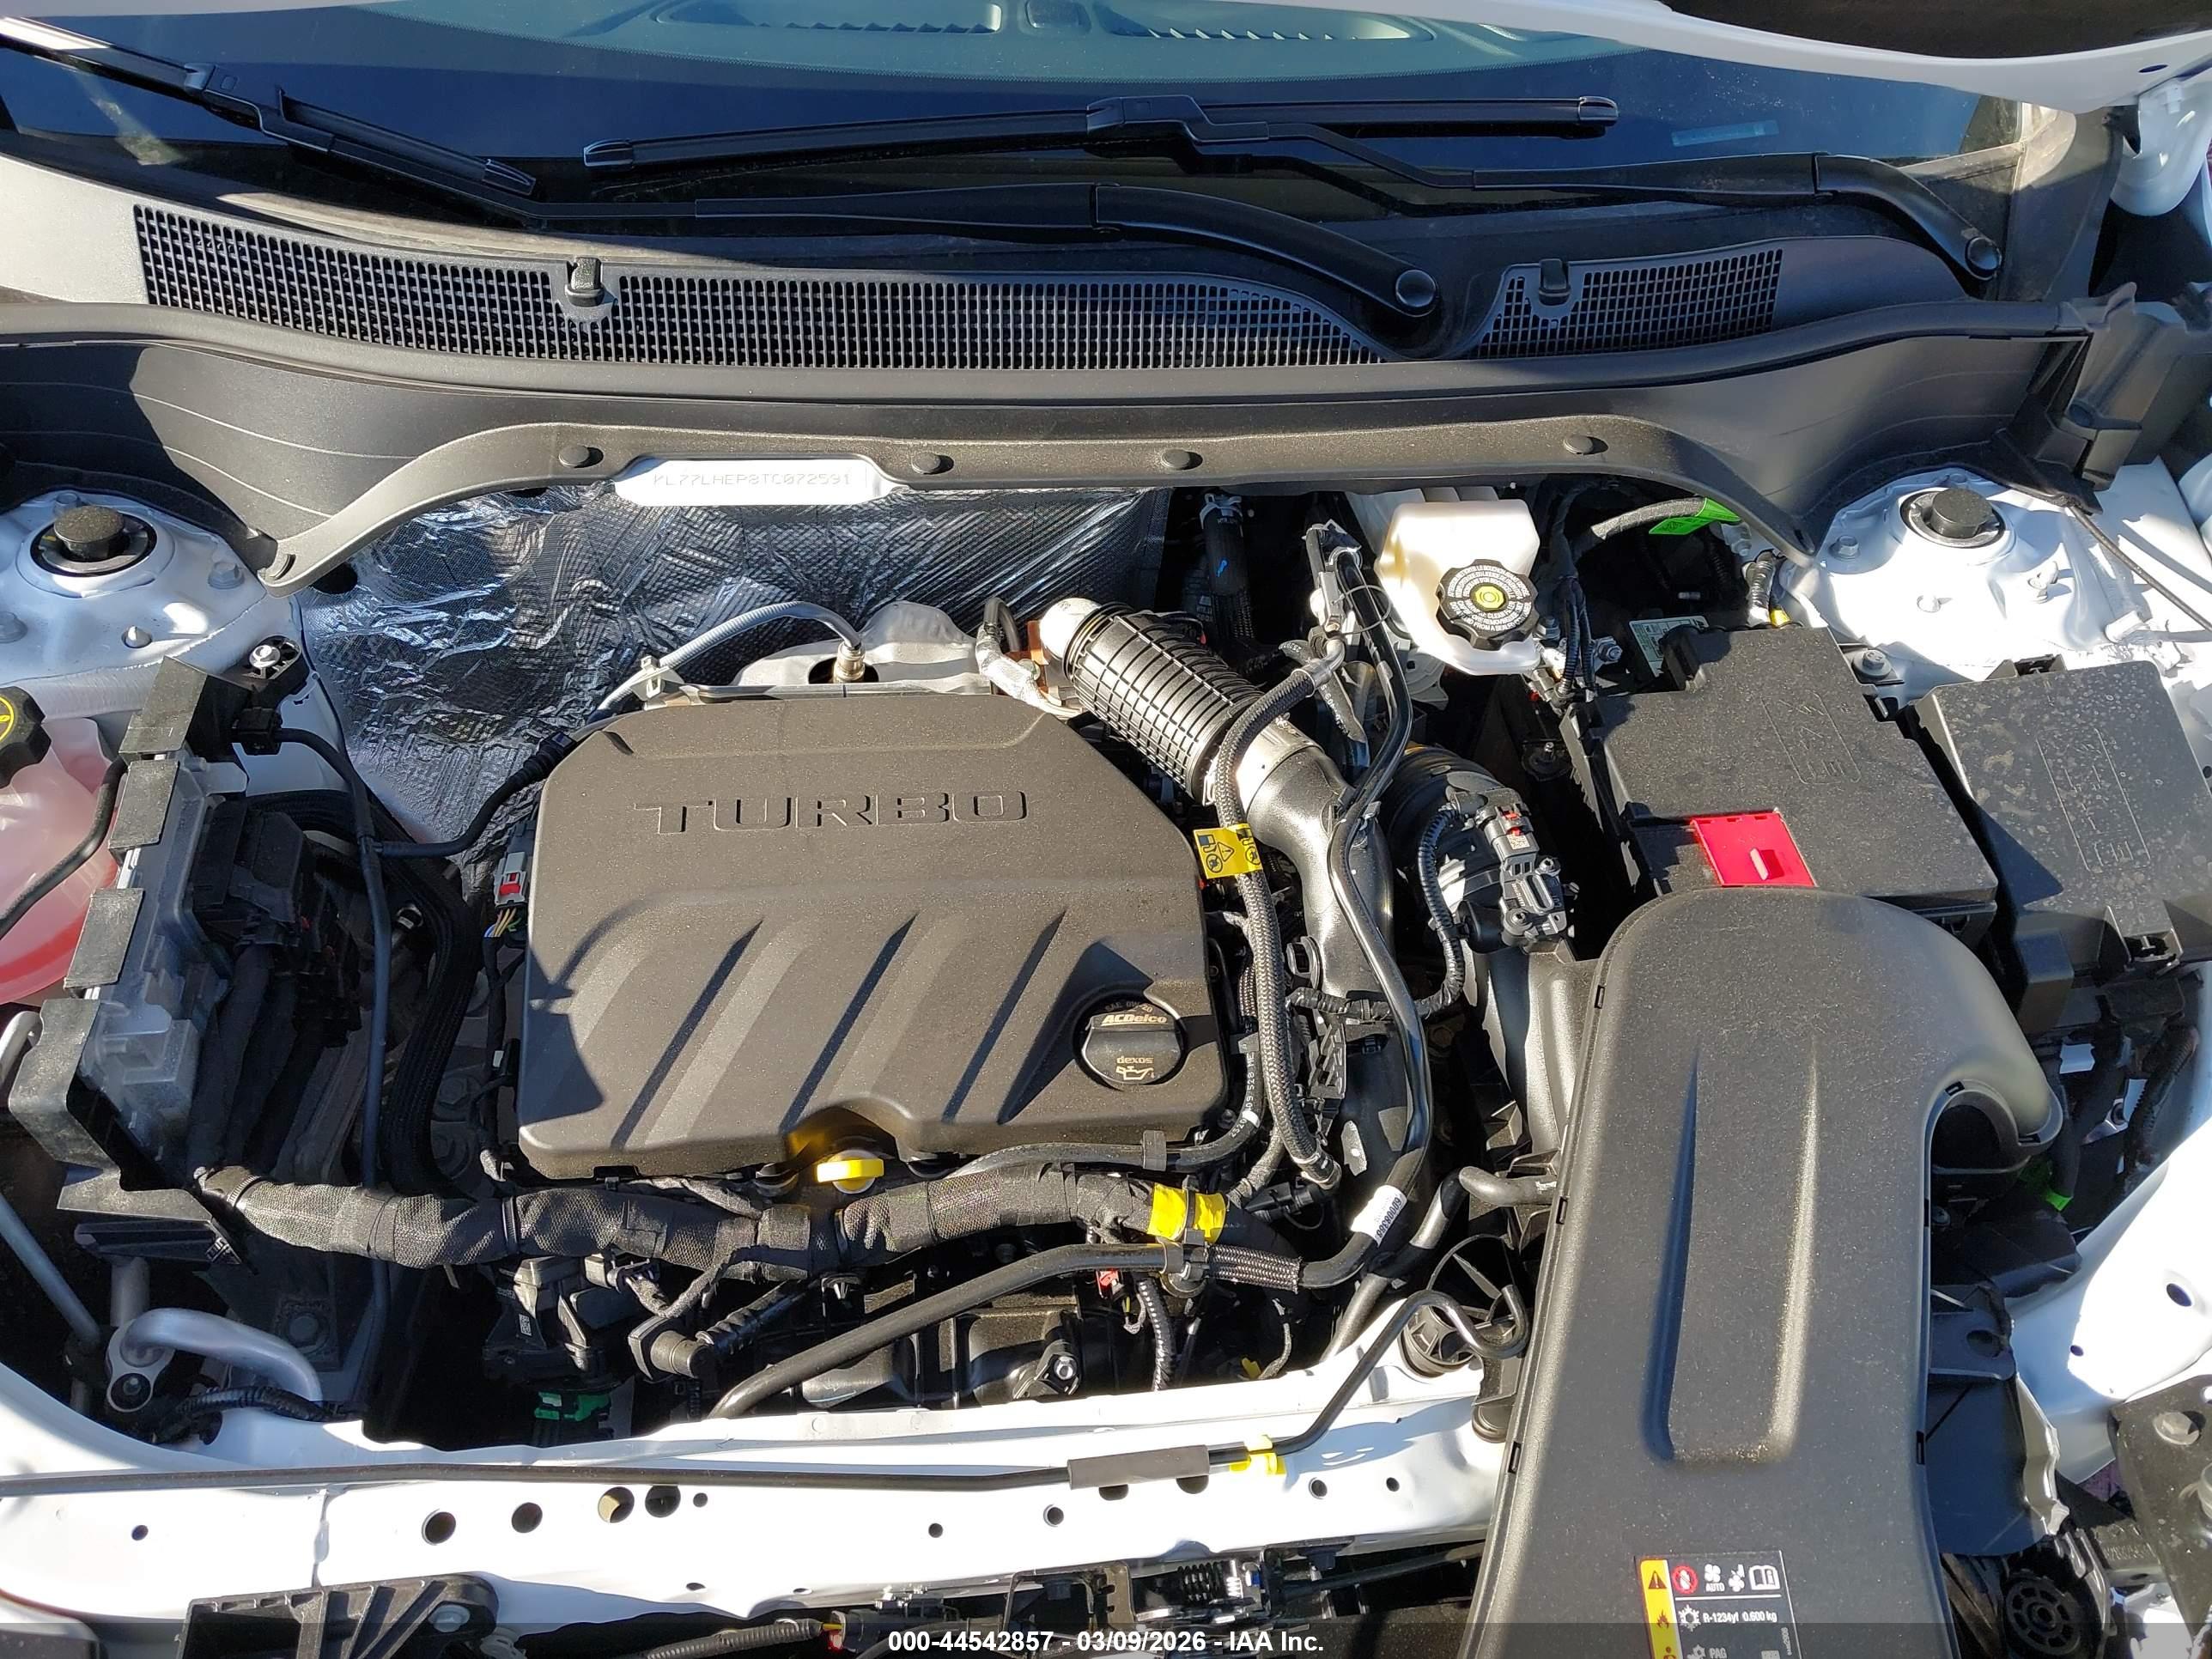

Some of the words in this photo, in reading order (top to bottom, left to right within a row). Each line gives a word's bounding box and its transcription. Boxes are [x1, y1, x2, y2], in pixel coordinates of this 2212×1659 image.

[634, 789, 1028, 835] TURBO
[1102, 1014, 1168, 1025] ACDelco
[1117, 1055, 1153, 1064] dexos
[1705, 1583, 1725, 1592] AUTO
[1703, 1613, 1740, 1624] R-1234yf
[1742, 1611, 1765, 1622] 0.600
[1766, 1611, 1778, 1623] kg
[1709, 1648, 1728, 1659] PAG
